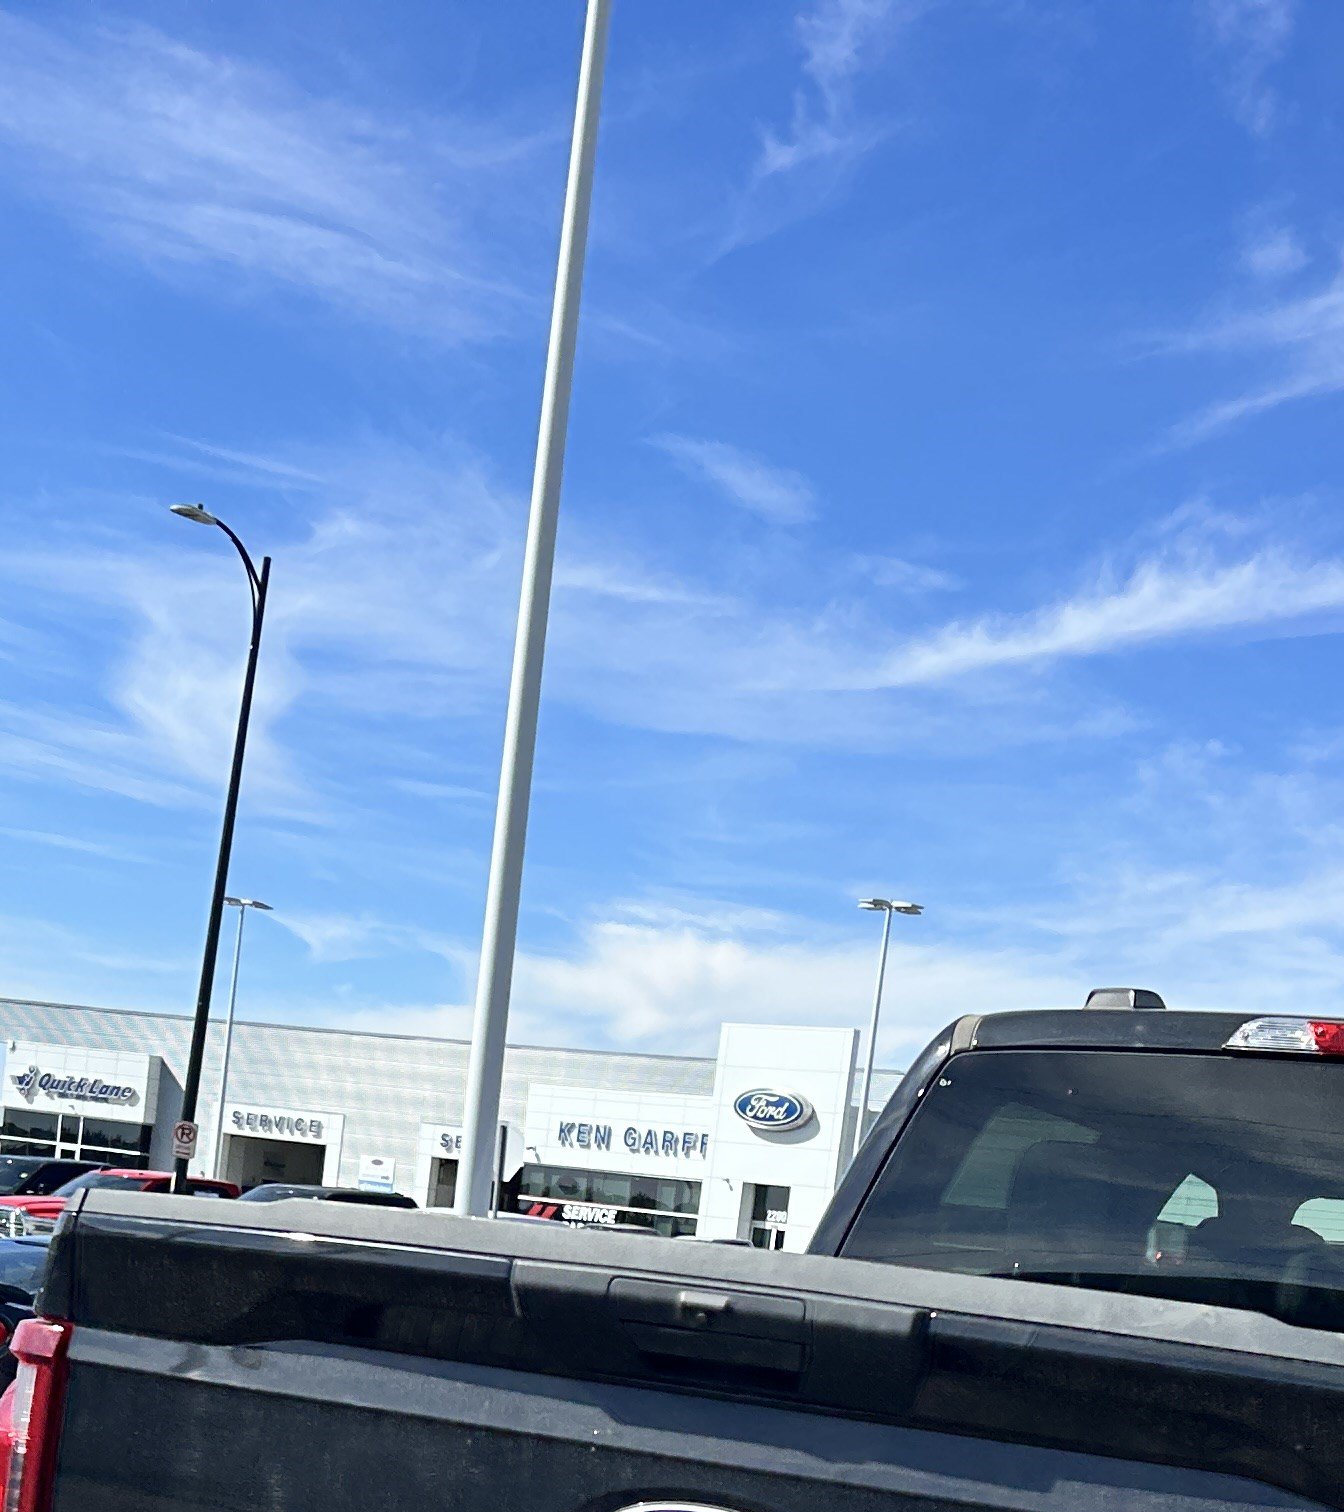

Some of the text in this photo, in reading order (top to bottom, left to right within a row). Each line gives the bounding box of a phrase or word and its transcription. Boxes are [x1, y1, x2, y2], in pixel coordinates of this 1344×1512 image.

[38, 1072, 87, 1093] Quick
[88, 1078, 134, 1098] Lane
[745, 1094, 791, 1120] Ford
[231, 1110, 324, 1135] SERVICE
[557, 1121, 609, 1148] KEN
[561, 1204, 618, 1224] SERVICE
